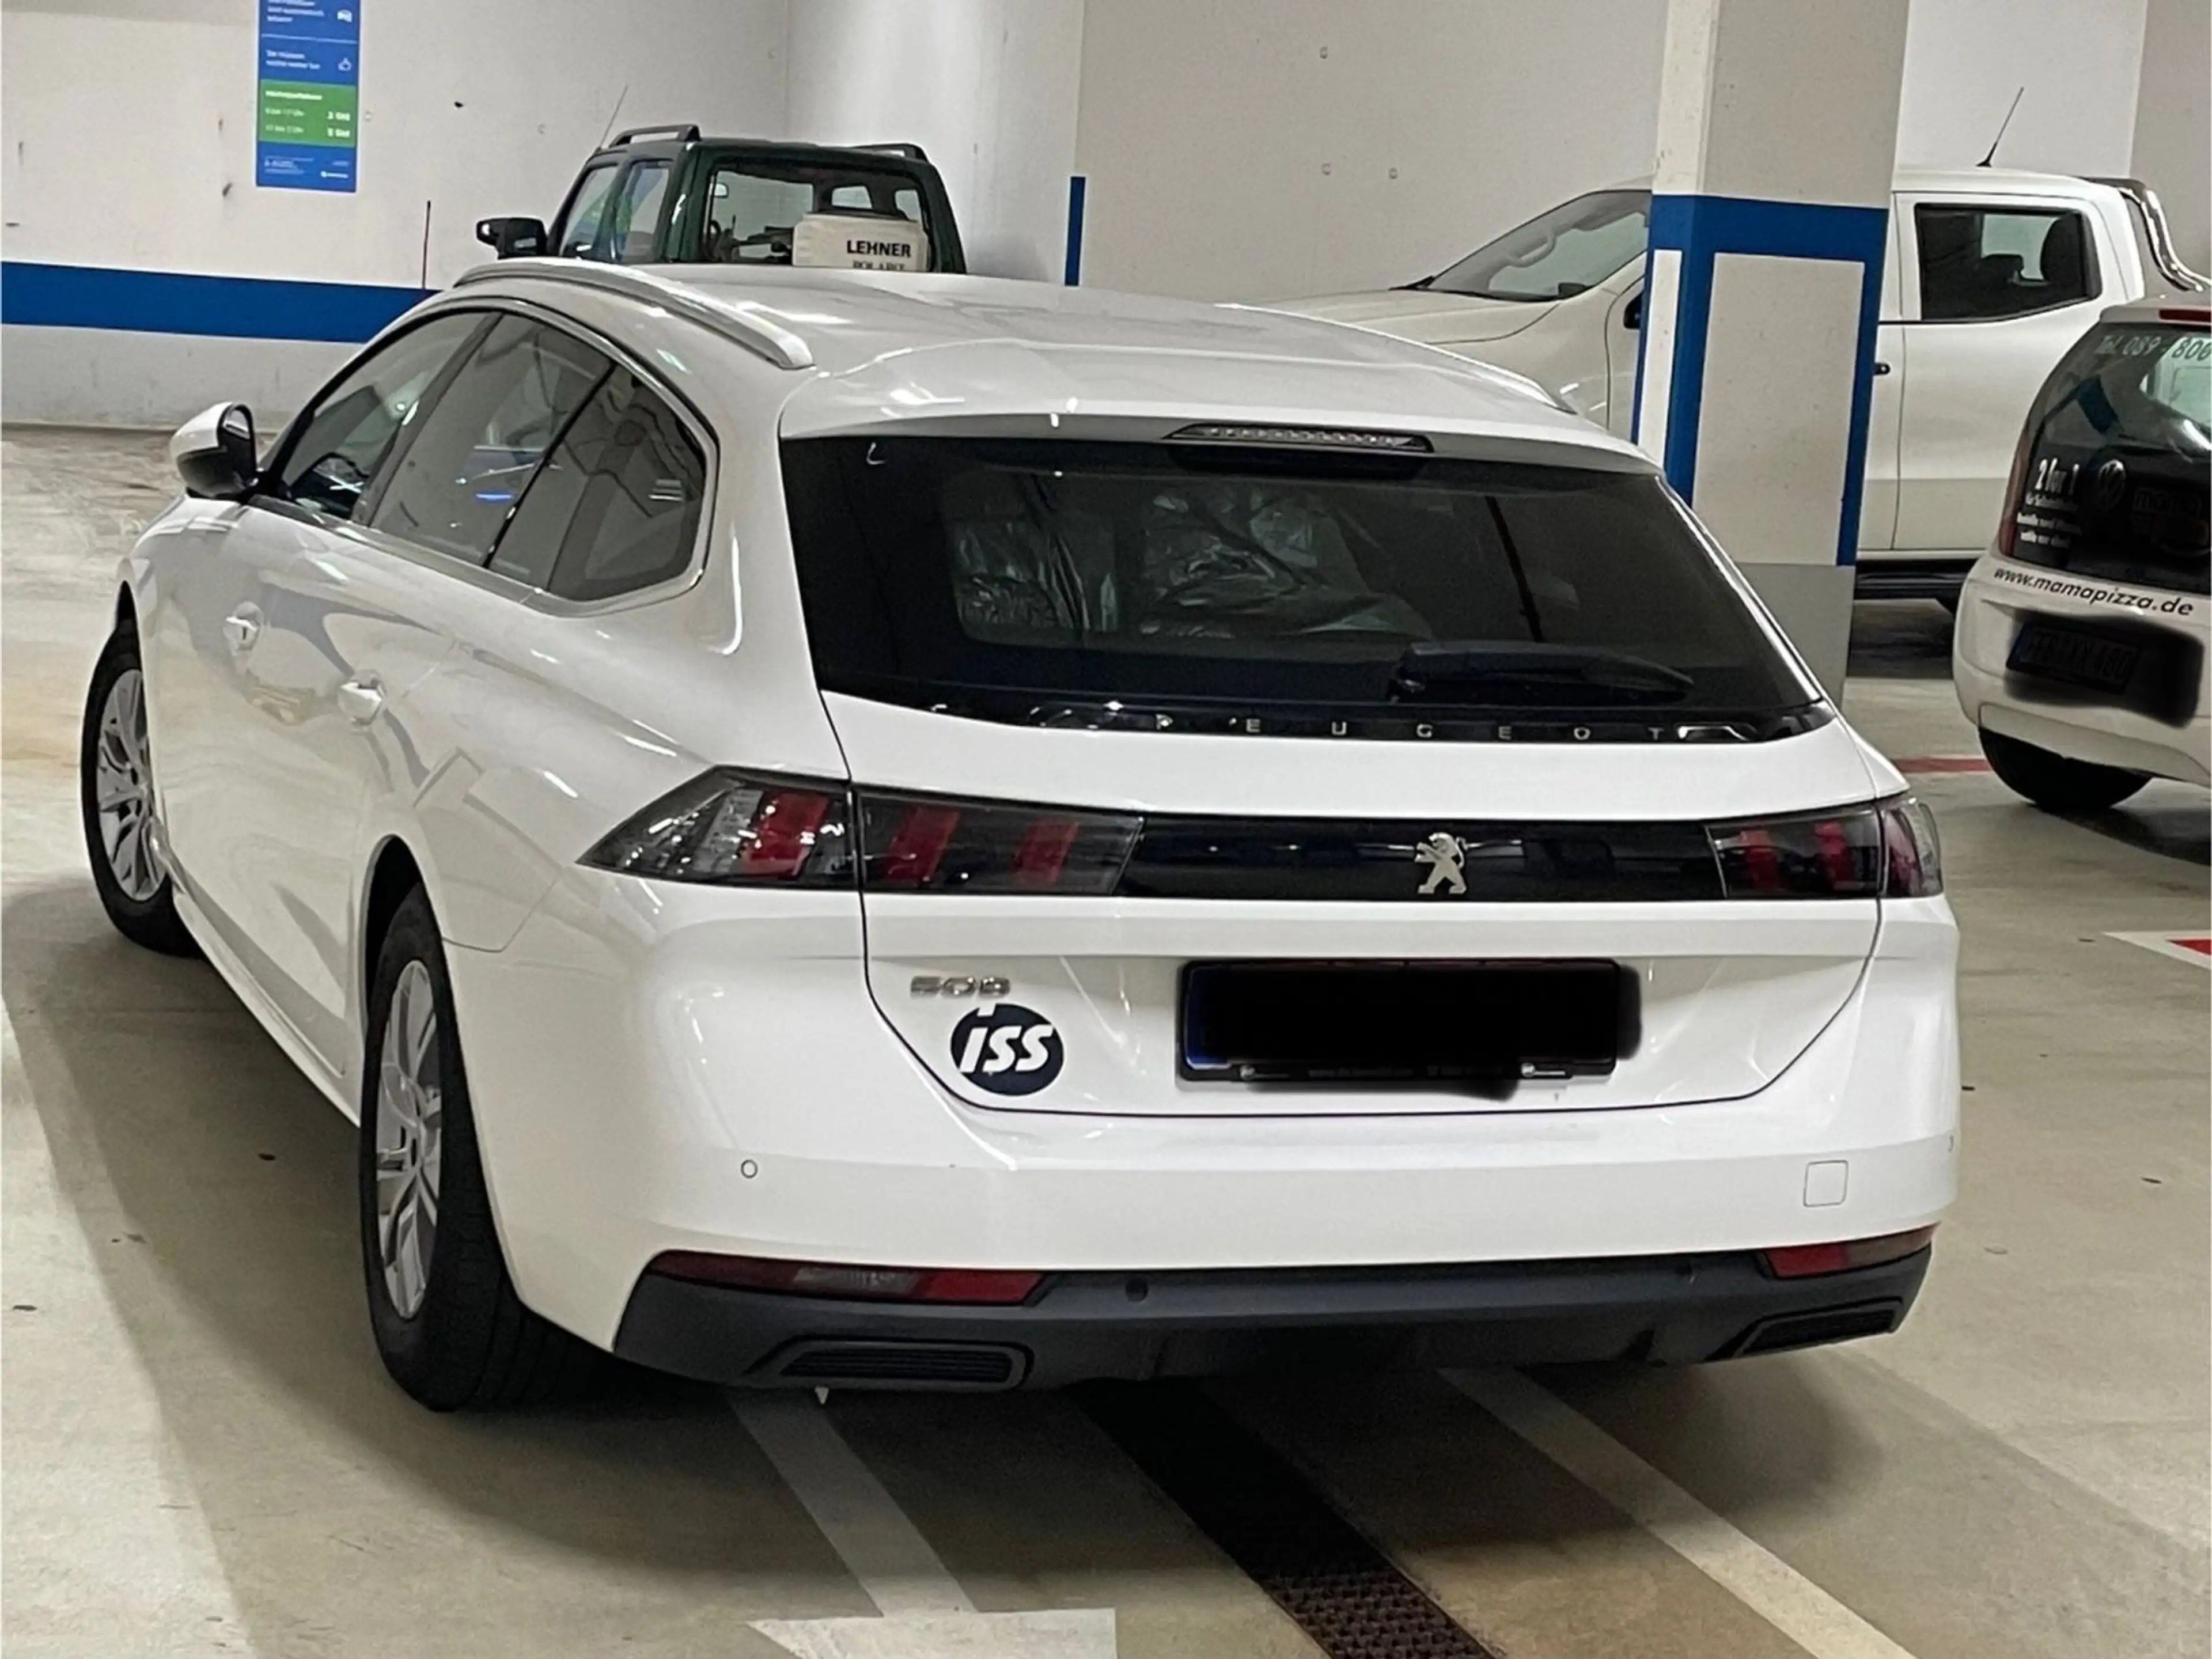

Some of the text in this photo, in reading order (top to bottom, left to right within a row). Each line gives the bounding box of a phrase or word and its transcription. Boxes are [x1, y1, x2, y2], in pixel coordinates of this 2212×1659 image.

[847, 239, 911, 258] LEHNER
[1993, 567, 2194, 616] www.mamapizza.de
[1156, 713, 1665, 740] PEUGEOT
